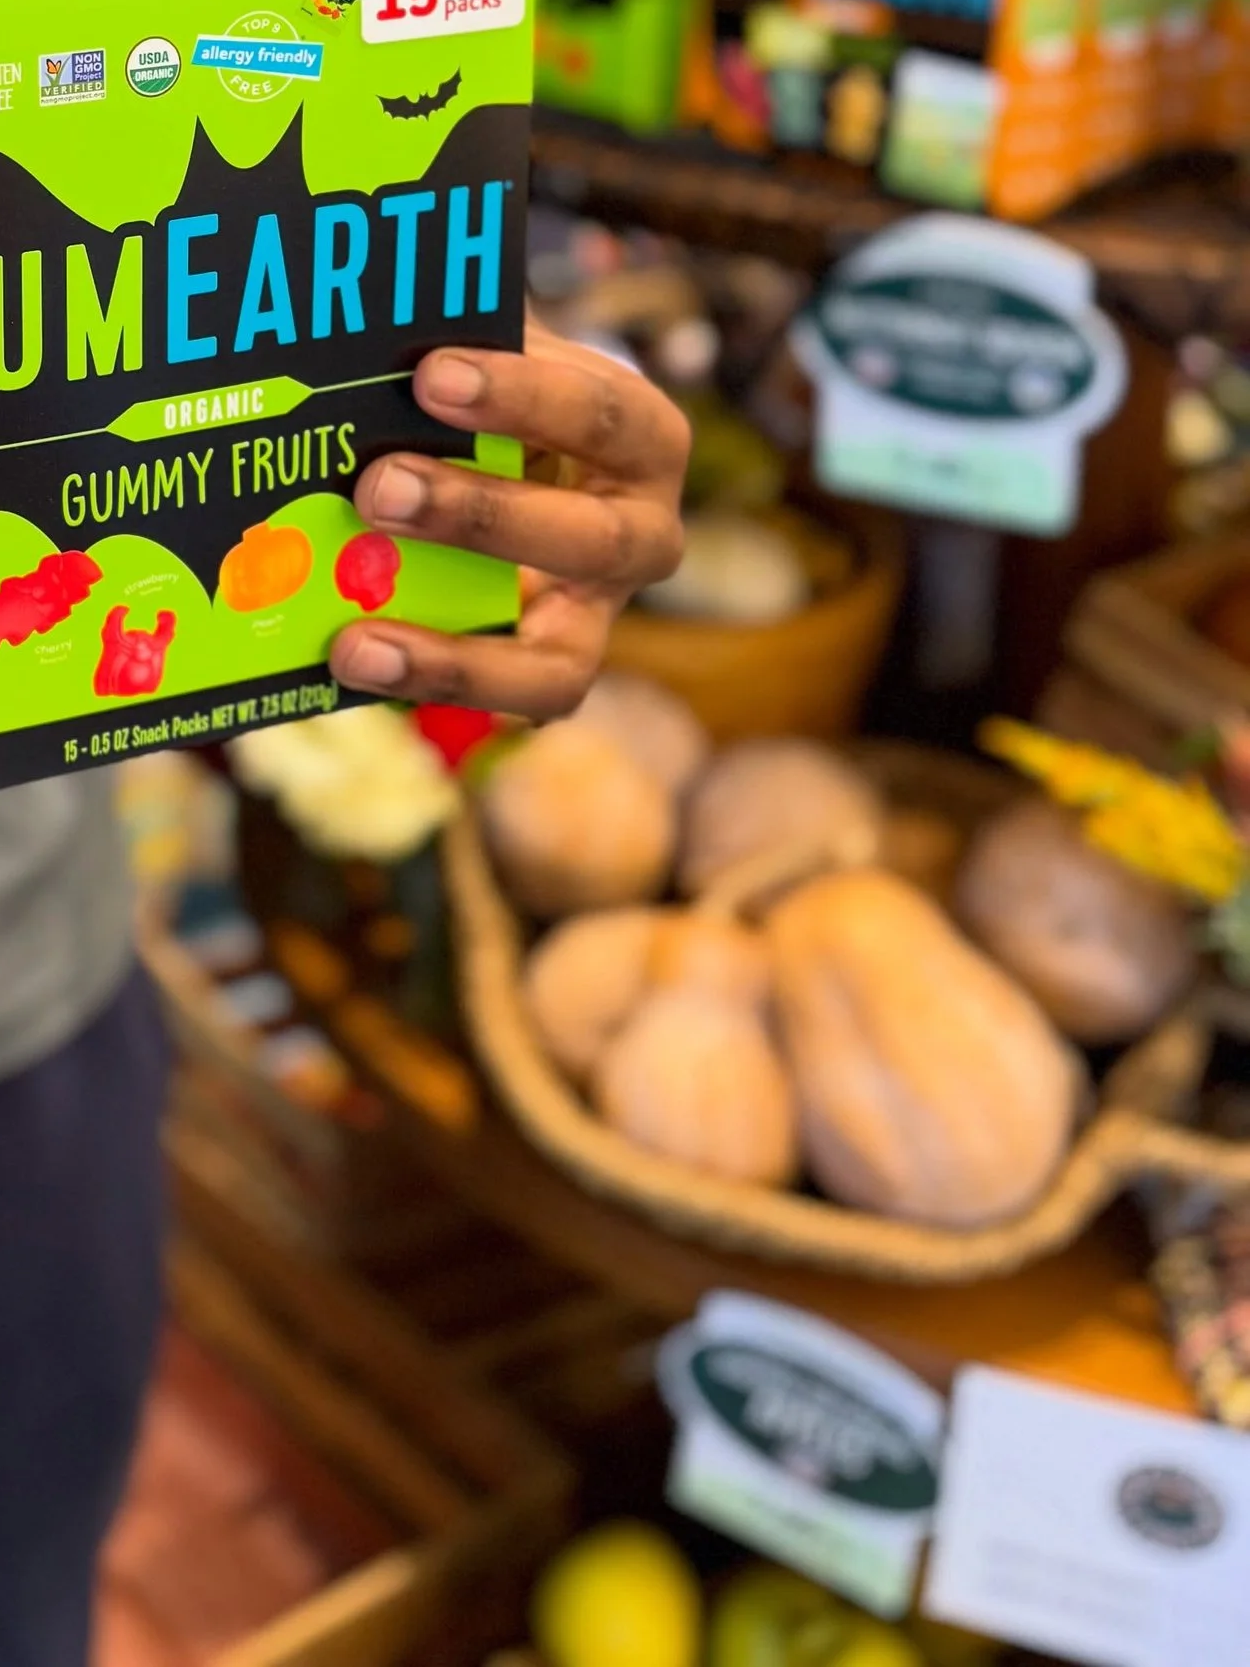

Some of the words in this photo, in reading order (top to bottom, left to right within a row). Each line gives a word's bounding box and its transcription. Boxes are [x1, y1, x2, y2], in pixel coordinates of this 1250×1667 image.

[242, 18, 270, 33] TOP
[75, 52, 102, 65] NON
[139, 51, 169, 66] USDA
[201, 45, 254, 65] allergy
[257, 47, 317, 68] friendly
[74, 62, 102, 74] GMO
[135, 67, 174, 82] ORGANIC
[75, 72, 102, 83] Project
[230, 75, 273, 96] FREE
[43, 81, 103, 97] VERIFIED
[164, 387, 265, 430] ORGANIC
[62, 447, 214, 527] GUMMY
[232, 422, 356, 498] FRUITS
[124, 573, 179, 595] strawberry
[34, 639, 73, 655] cherry
[64, 739, 78, 764] 15
[91, 732, 111, 757] 0.5
[113, 727, 129, 752] OZ
[132, 719, 169, 748] Snack
[172, 710, 209, 738] Packs
[211, 702, 235, 730] NET
